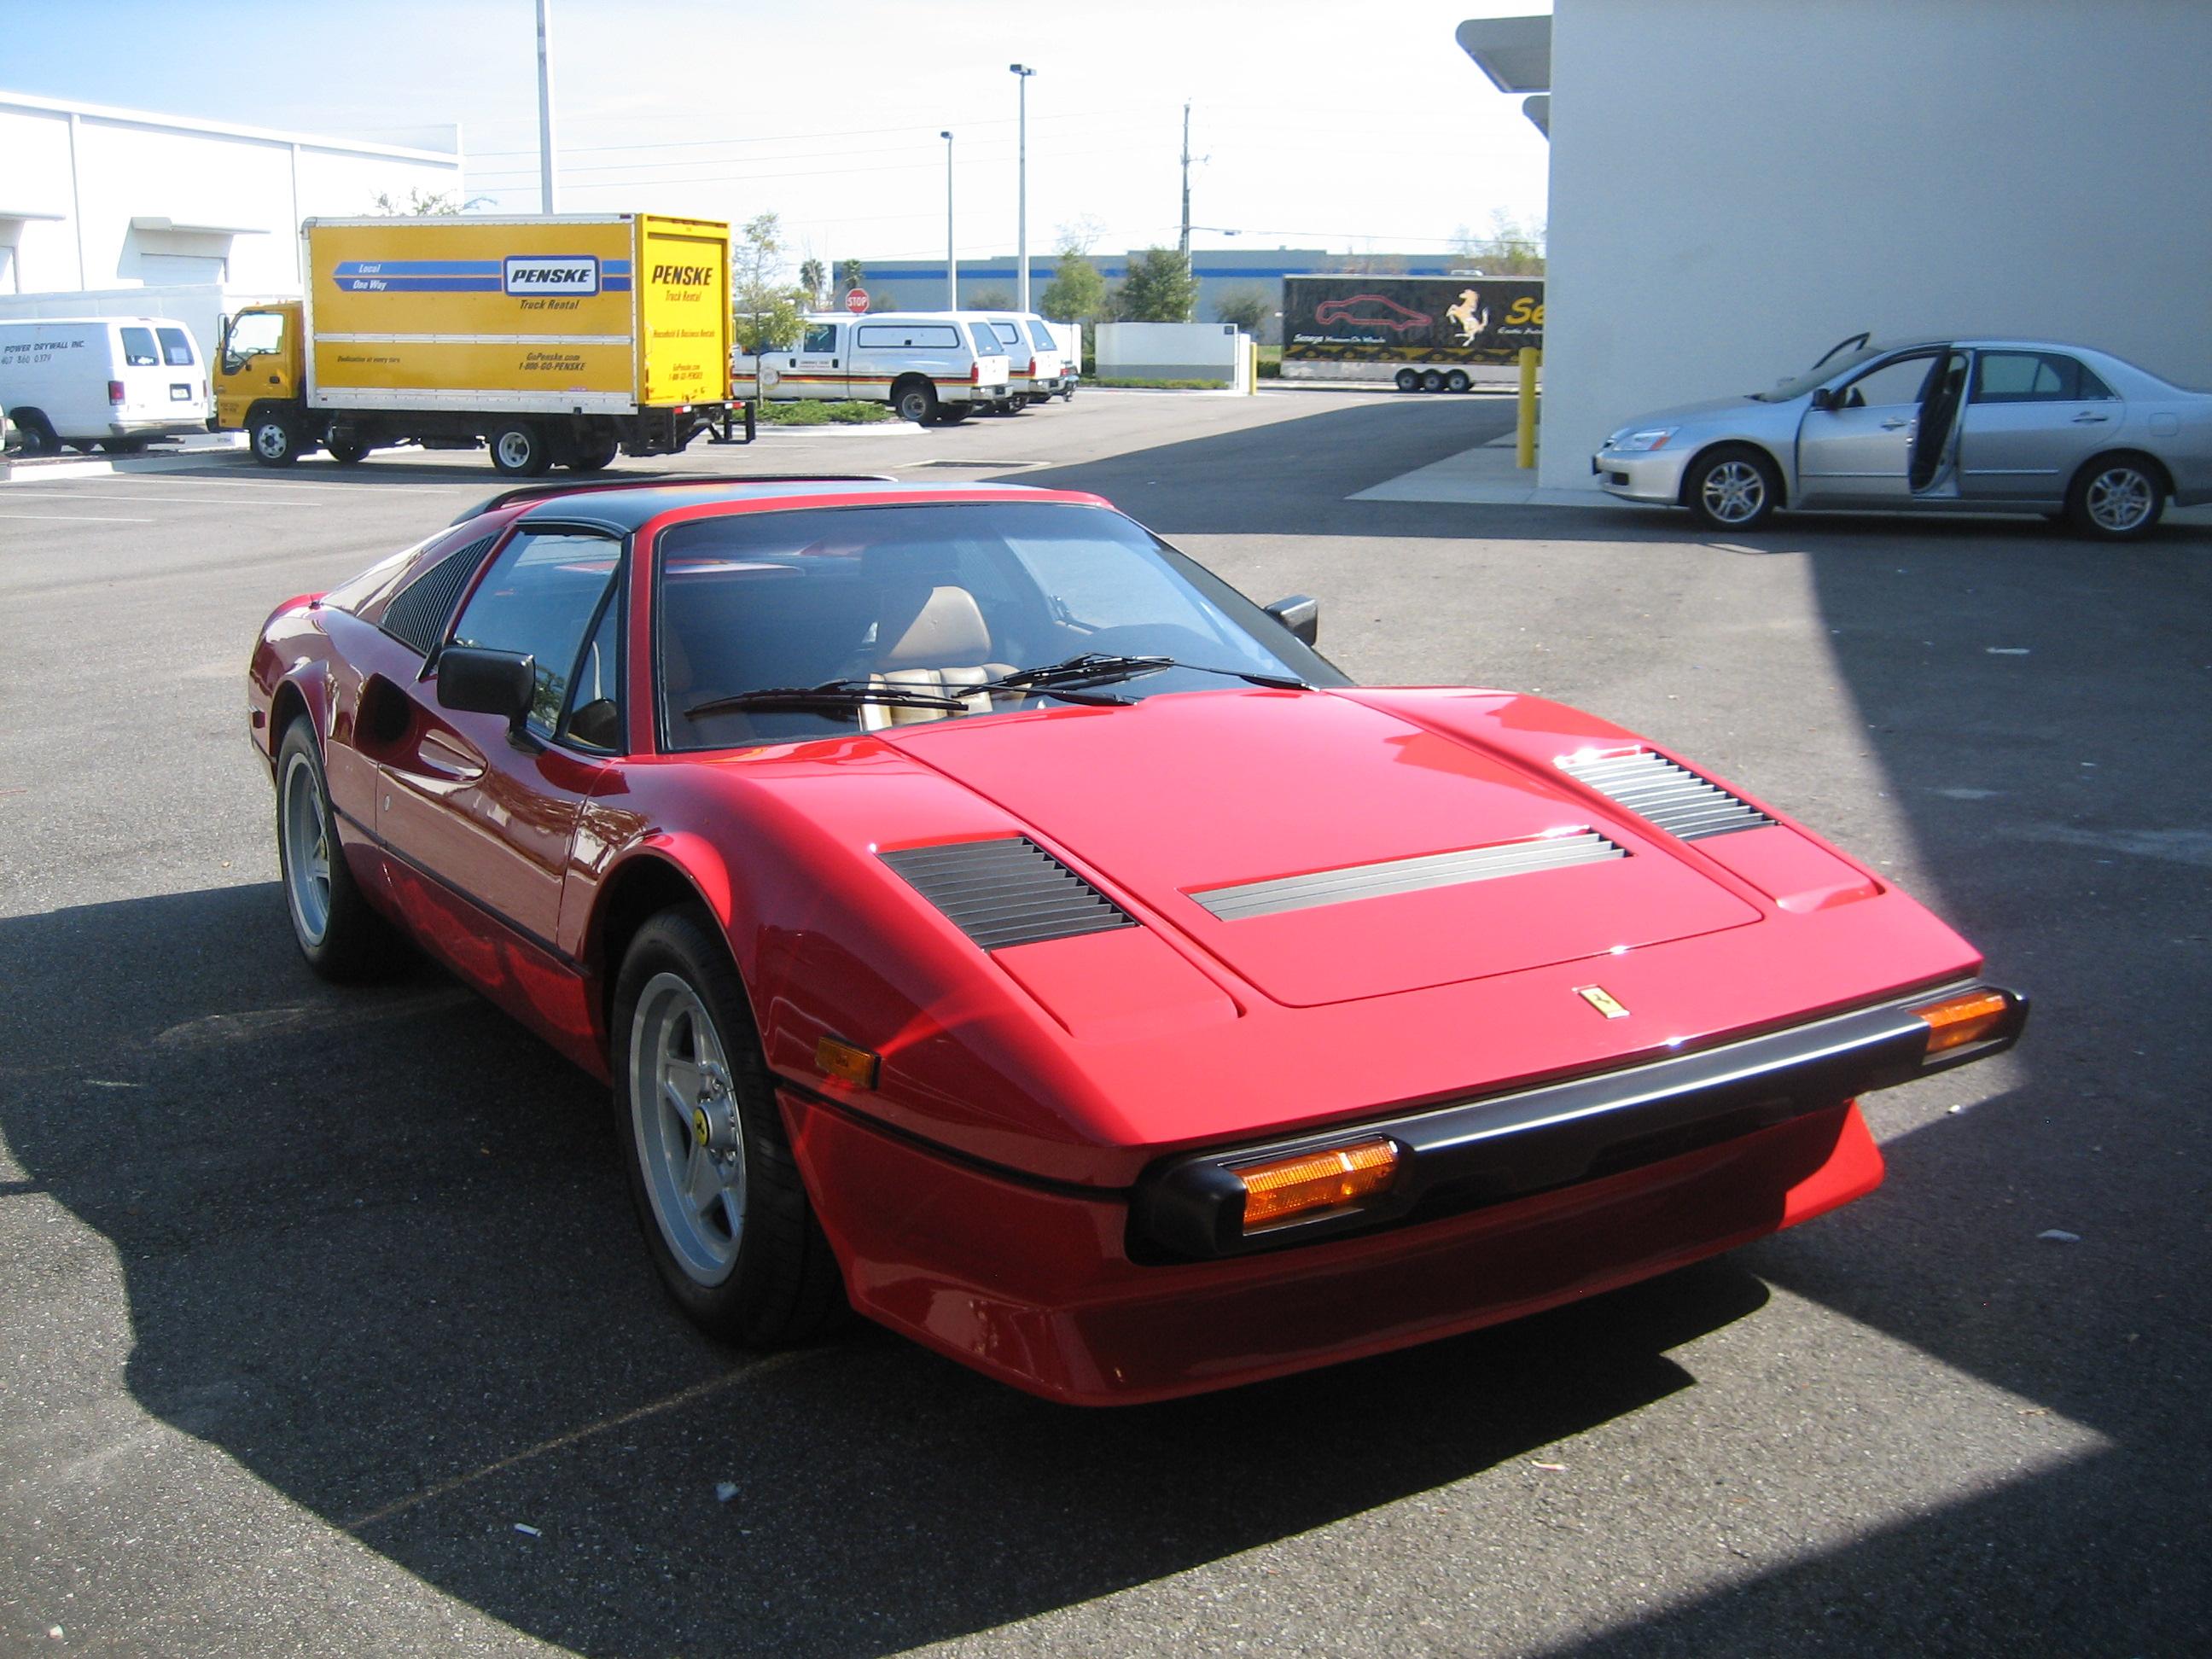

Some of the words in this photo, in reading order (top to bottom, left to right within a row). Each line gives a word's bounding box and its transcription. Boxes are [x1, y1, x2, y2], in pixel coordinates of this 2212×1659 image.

[358, 264, 381, 273] Local
[511, 269, 591, 283] PENSKE
[651, 265, 713, 286] PENSKE
[352, 280, 368, 289] One
[369, 280, 387, 291] Way
[666, 290, 681, 301] Truck
[683, 290, 702, 302] Rental
[847, 296, 867, 307] STOP
[521, 300, 546, 310] Truck
[547, 300, 580, 310] Rental
[4, 344, 31, 353] POWER
[34, 341, 68, 351] DRYWALL
